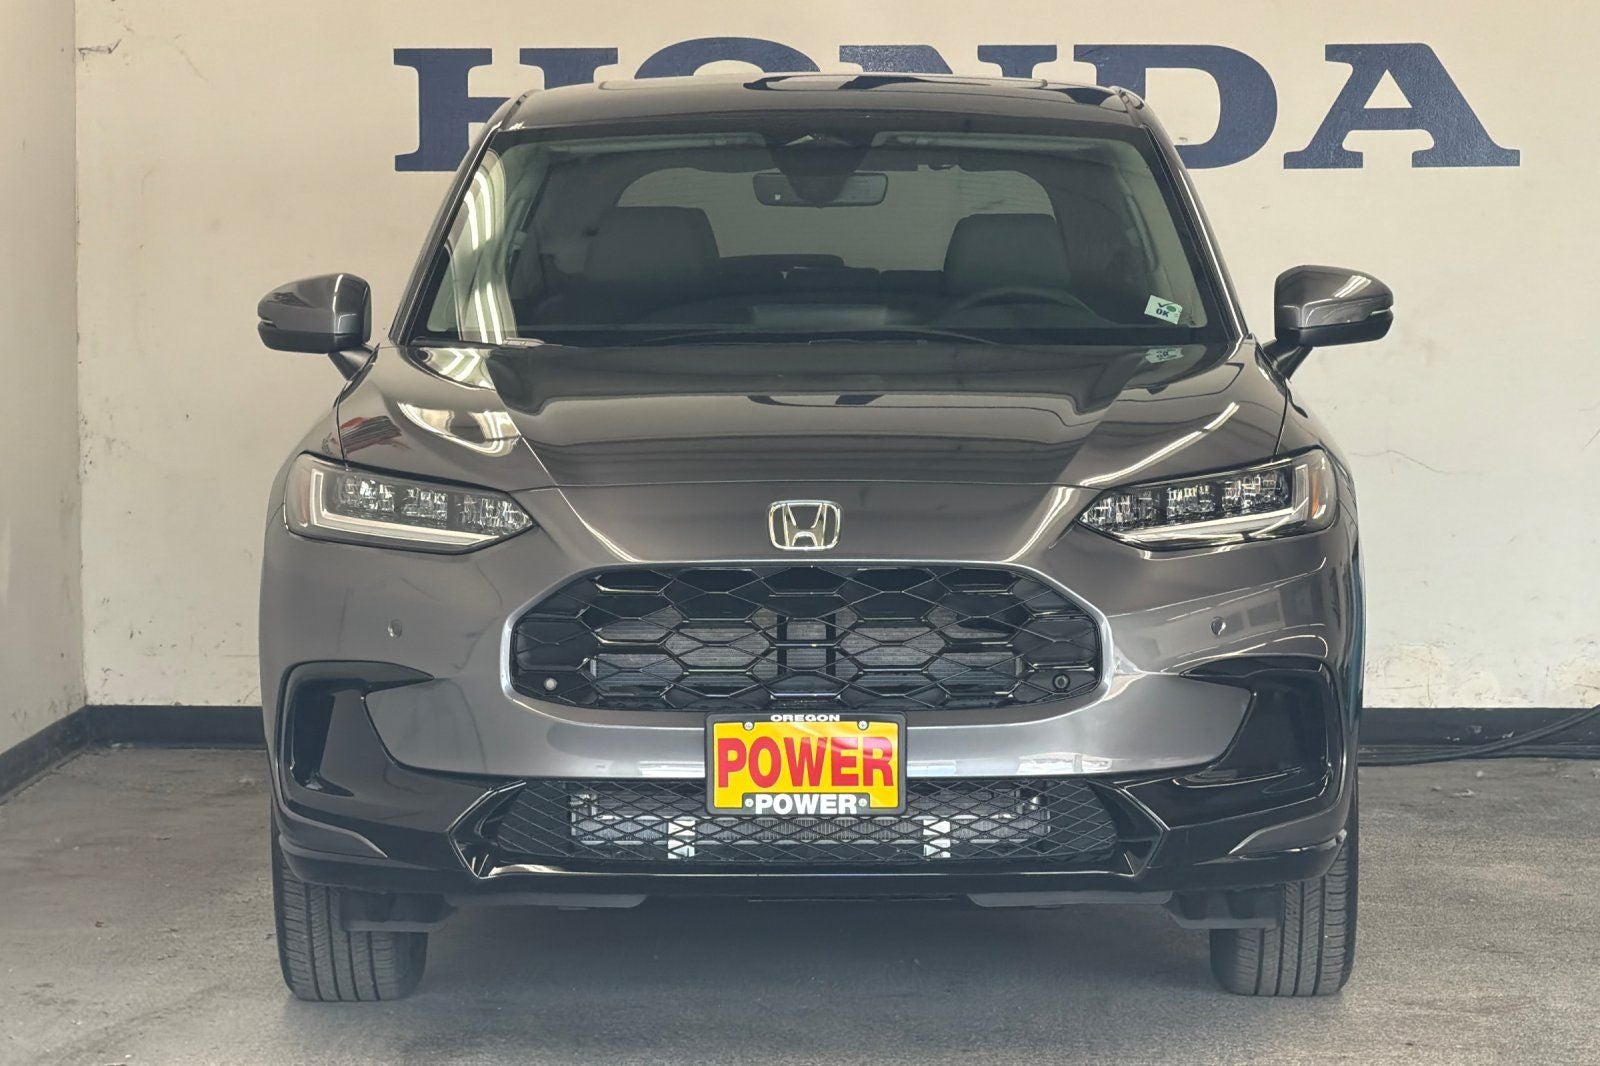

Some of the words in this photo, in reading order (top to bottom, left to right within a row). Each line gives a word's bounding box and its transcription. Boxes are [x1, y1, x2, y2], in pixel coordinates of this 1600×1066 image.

[394, 37, 1520, 172] HDA
[1156, 308, 1169, 317] OK
[770, 714, 840, 722] OREGON
[717, 736, 894, 788] POWER
[755, 794, 857, 815] POWER
